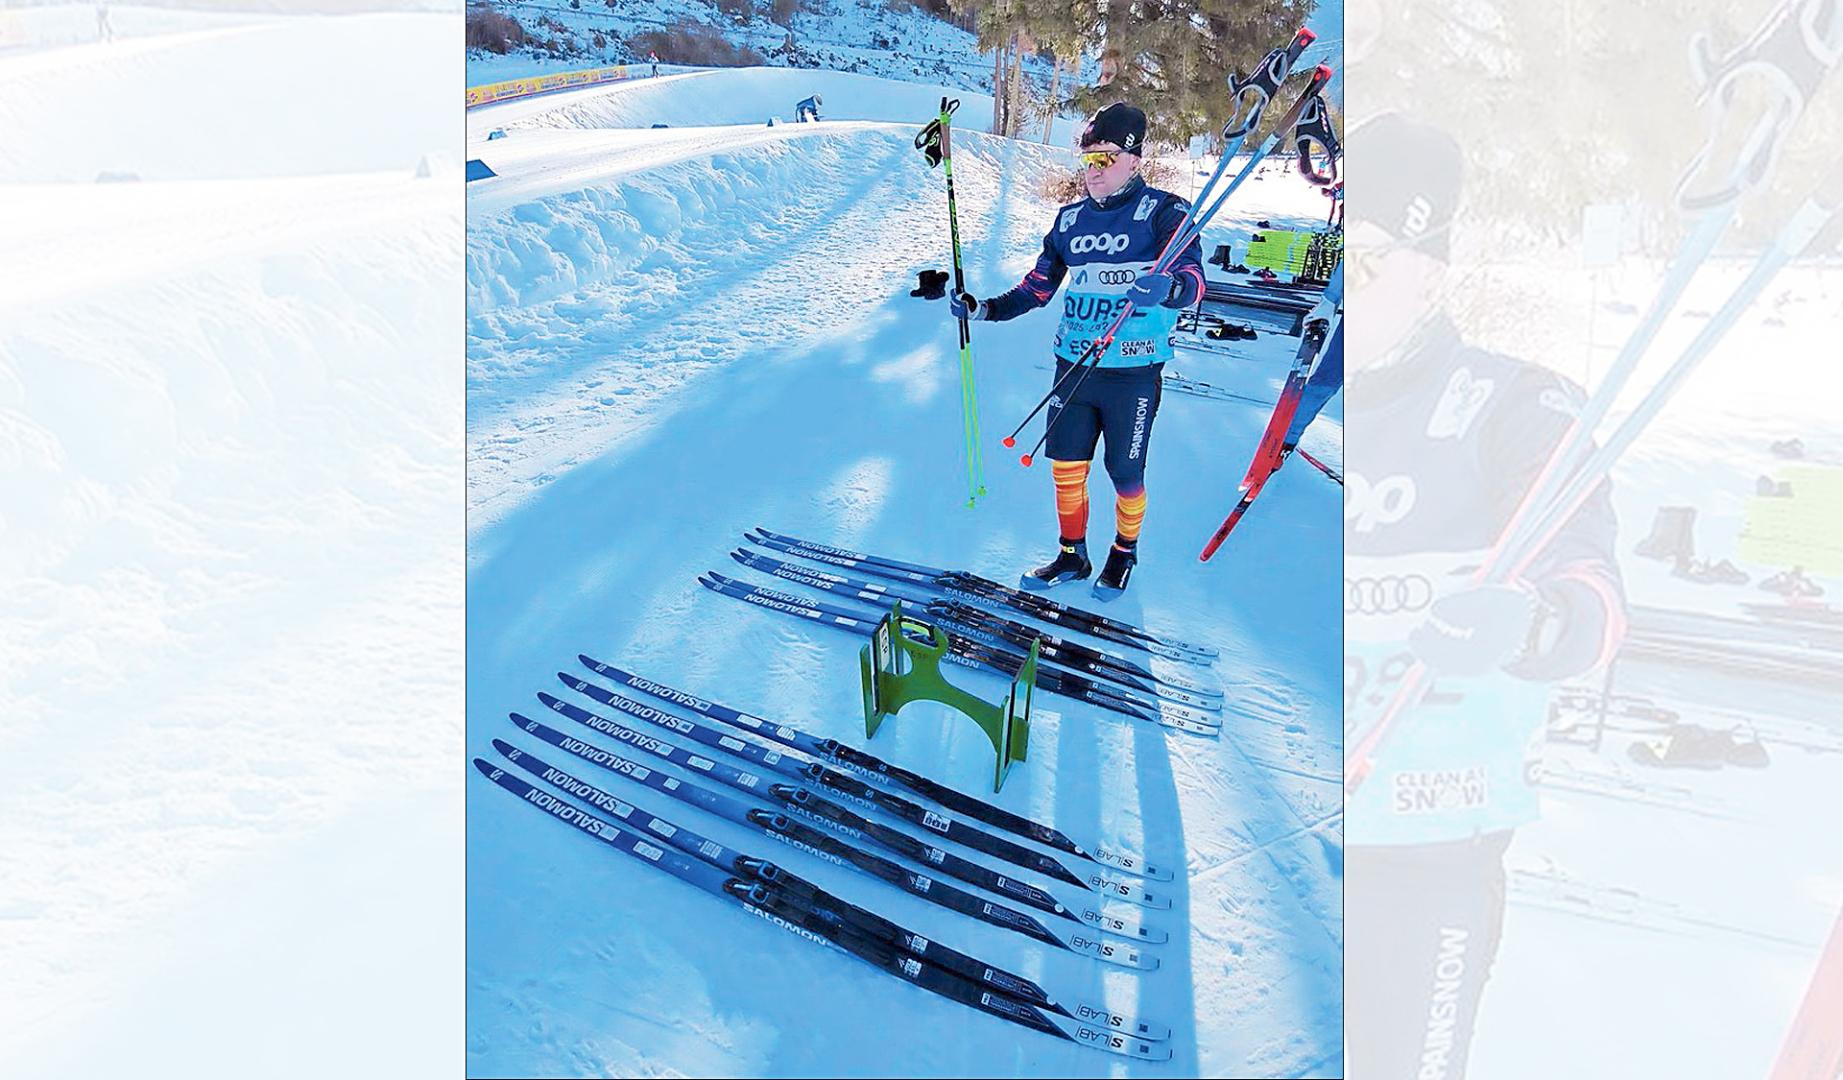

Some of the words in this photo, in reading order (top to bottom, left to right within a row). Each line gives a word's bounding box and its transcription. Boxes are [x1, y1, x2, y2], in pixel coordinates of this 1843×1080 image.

[1070, 232, 1130, 255] coop
[1129, 397, 1149, 460] SPAINSNOW
[786, 546, 845, 565] SALOMON
[797, 541, 856, 558] SALOMON
[773, 568, 834, 589] SALOMON
[744, 593, 808, 616] SALOMON
[754, 586, 819, 608] SALOMON
[944, 587, 999, 608] SALOMON
[936, 618, 994, 641] SALOMON
[627, 676, 698, 708] SALOMON
[608, 694, 680, 729] SALOMON
[586, 715, 659, 750] SALOMON
[560, 737, 635, 774] SALOMON
[819, 751, 889, 785] SALOMON
[542, 767, 621, 812] SALOMON
[804, 777, 877, 811] SALOMON
[525, 788, 604, 834] SALOMON
[786, 802, 862, 839] SALOMON
[765, 828, 843, 866] SALOMON
[743, 902, 828, 946] SALOMON
